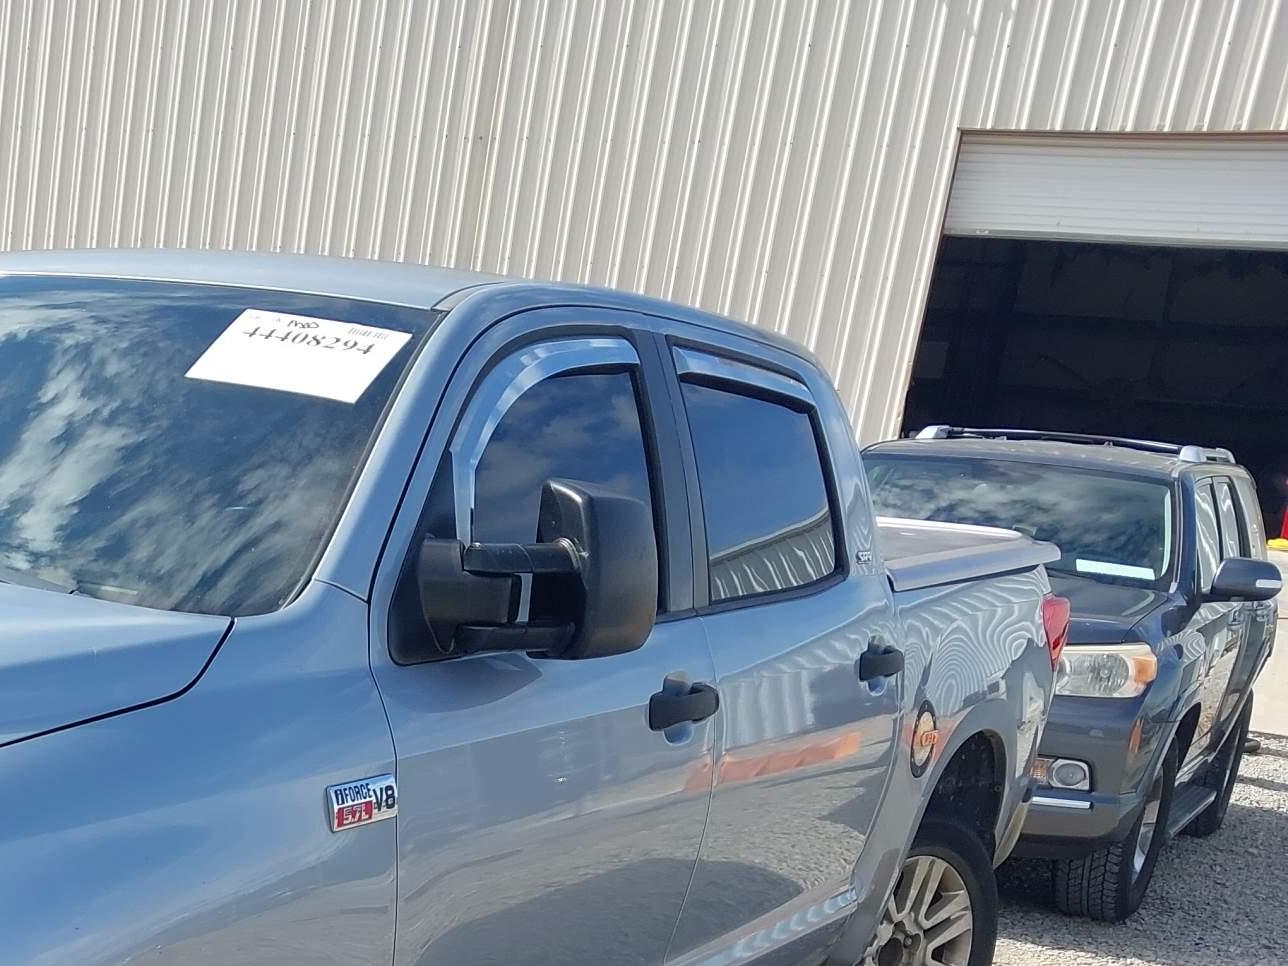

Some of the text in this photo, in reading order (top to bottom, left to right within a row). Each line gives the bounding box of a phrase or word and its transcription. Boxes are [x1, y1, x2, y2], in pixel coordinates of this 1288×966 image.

[243, 326, 375, 355] 44408294
[373, 785, 396, 812] V8
[343, 803, 370, 824] 5.7L
